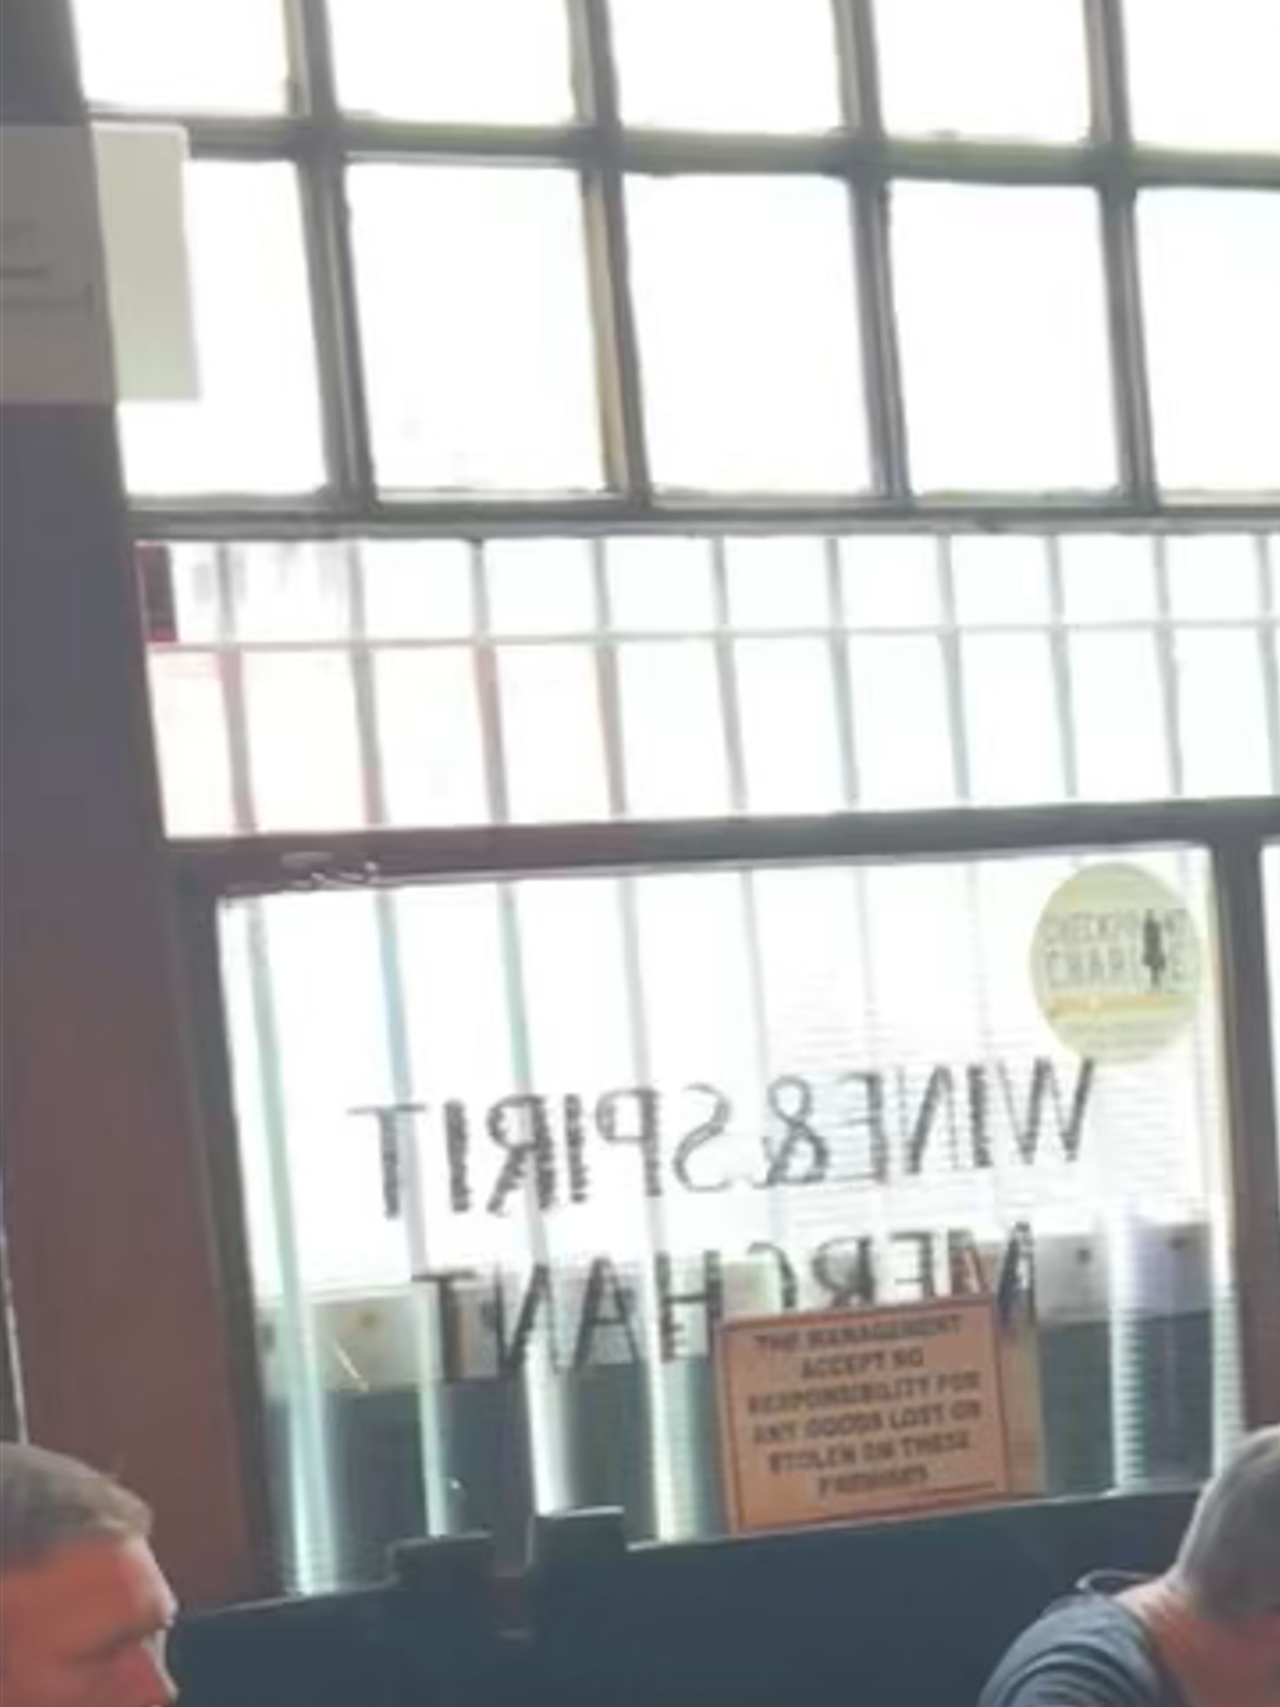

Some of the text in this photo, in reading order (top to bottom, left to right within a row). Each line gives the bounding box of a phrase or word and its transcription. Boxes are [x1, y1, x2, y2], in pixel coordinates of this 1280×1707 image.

[807, 1314, 962, 1346] MANAGEMENT
[801, 1346, 925, 1379] ACCEPT NO
[747, 1370, 981, 1415] RESPONSIBILITY FOR
[754, 1420, 797, 1444] ANY
[806, 1411, 883, 1440] GOODS
[888, 1403, 946, 1431] LOST
[768, 1445, 857, 1476] STOLEN
[899, 1430, 970, 1459] THESE
